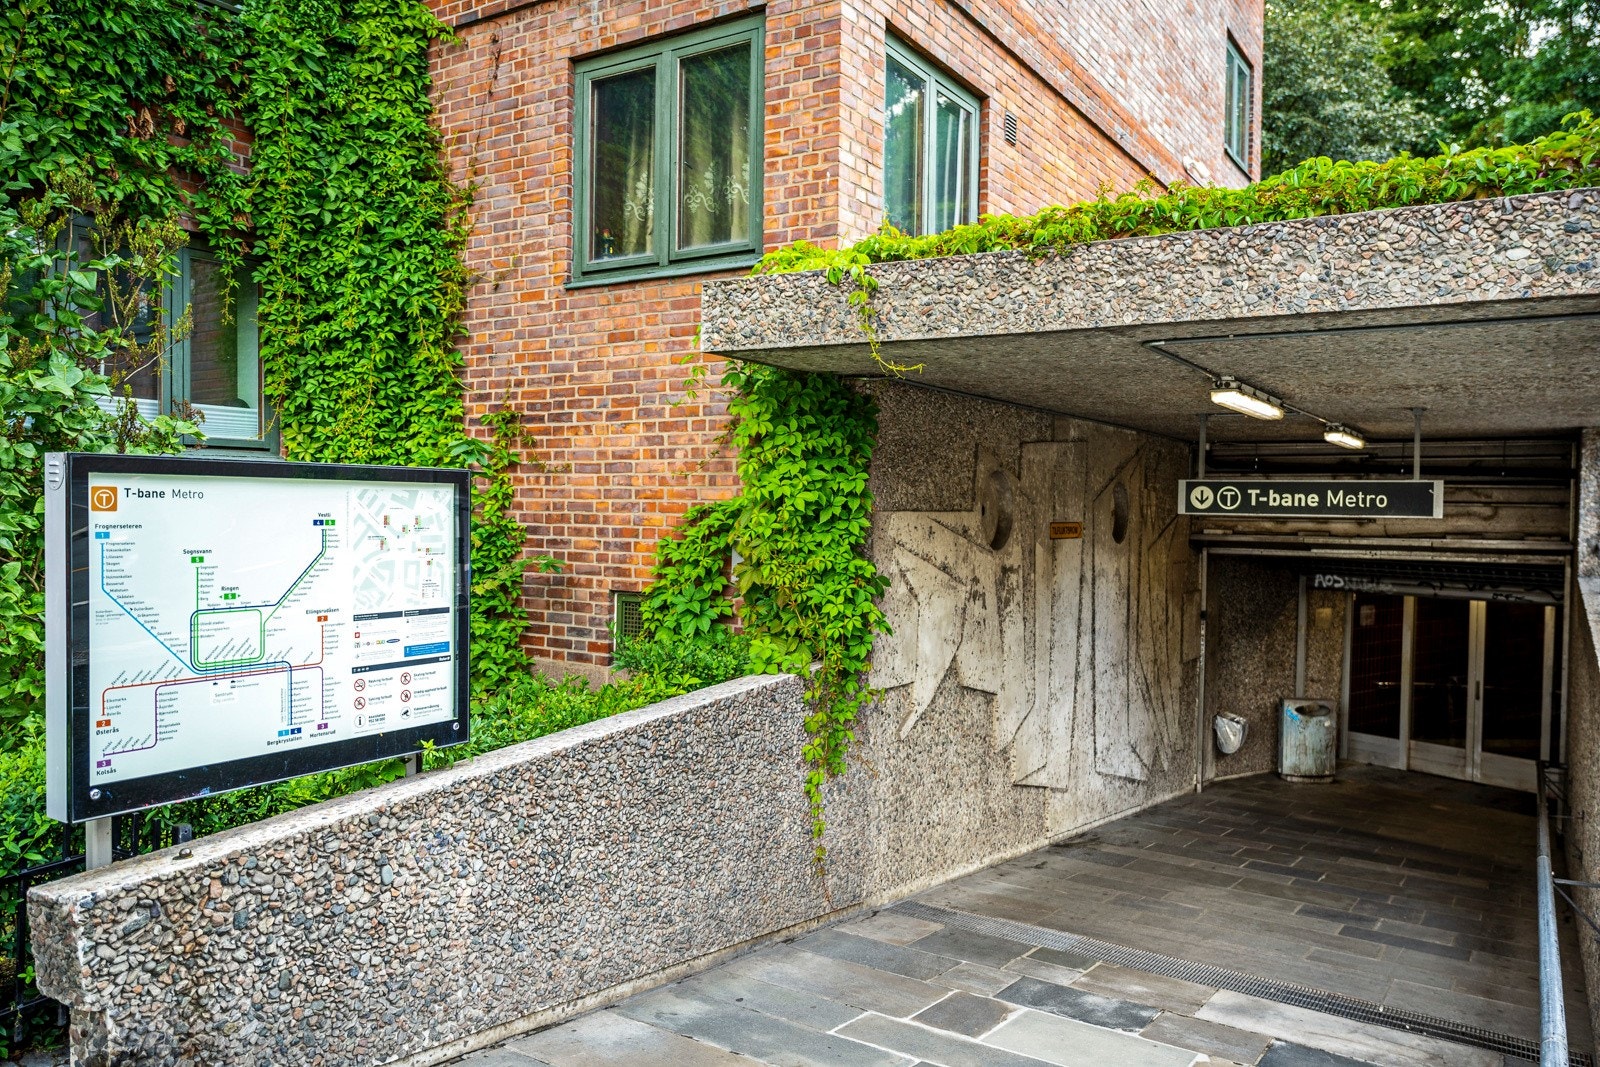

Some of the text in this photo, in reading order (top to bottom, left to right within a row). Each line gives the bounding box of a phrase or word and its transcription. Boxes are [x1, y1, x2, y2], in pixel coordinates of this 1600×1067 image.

[124, 488, 204, 499] T-bane Metro
[1248, 489, 1387, 508] T-bane Metro
[96, 727, 119, 735] Østerås
[310, 730, 336, 738] Mortensrud
[267, 736, 302, 746] Bergkrystallen
[97, 768, 116, 776] Kolsås
